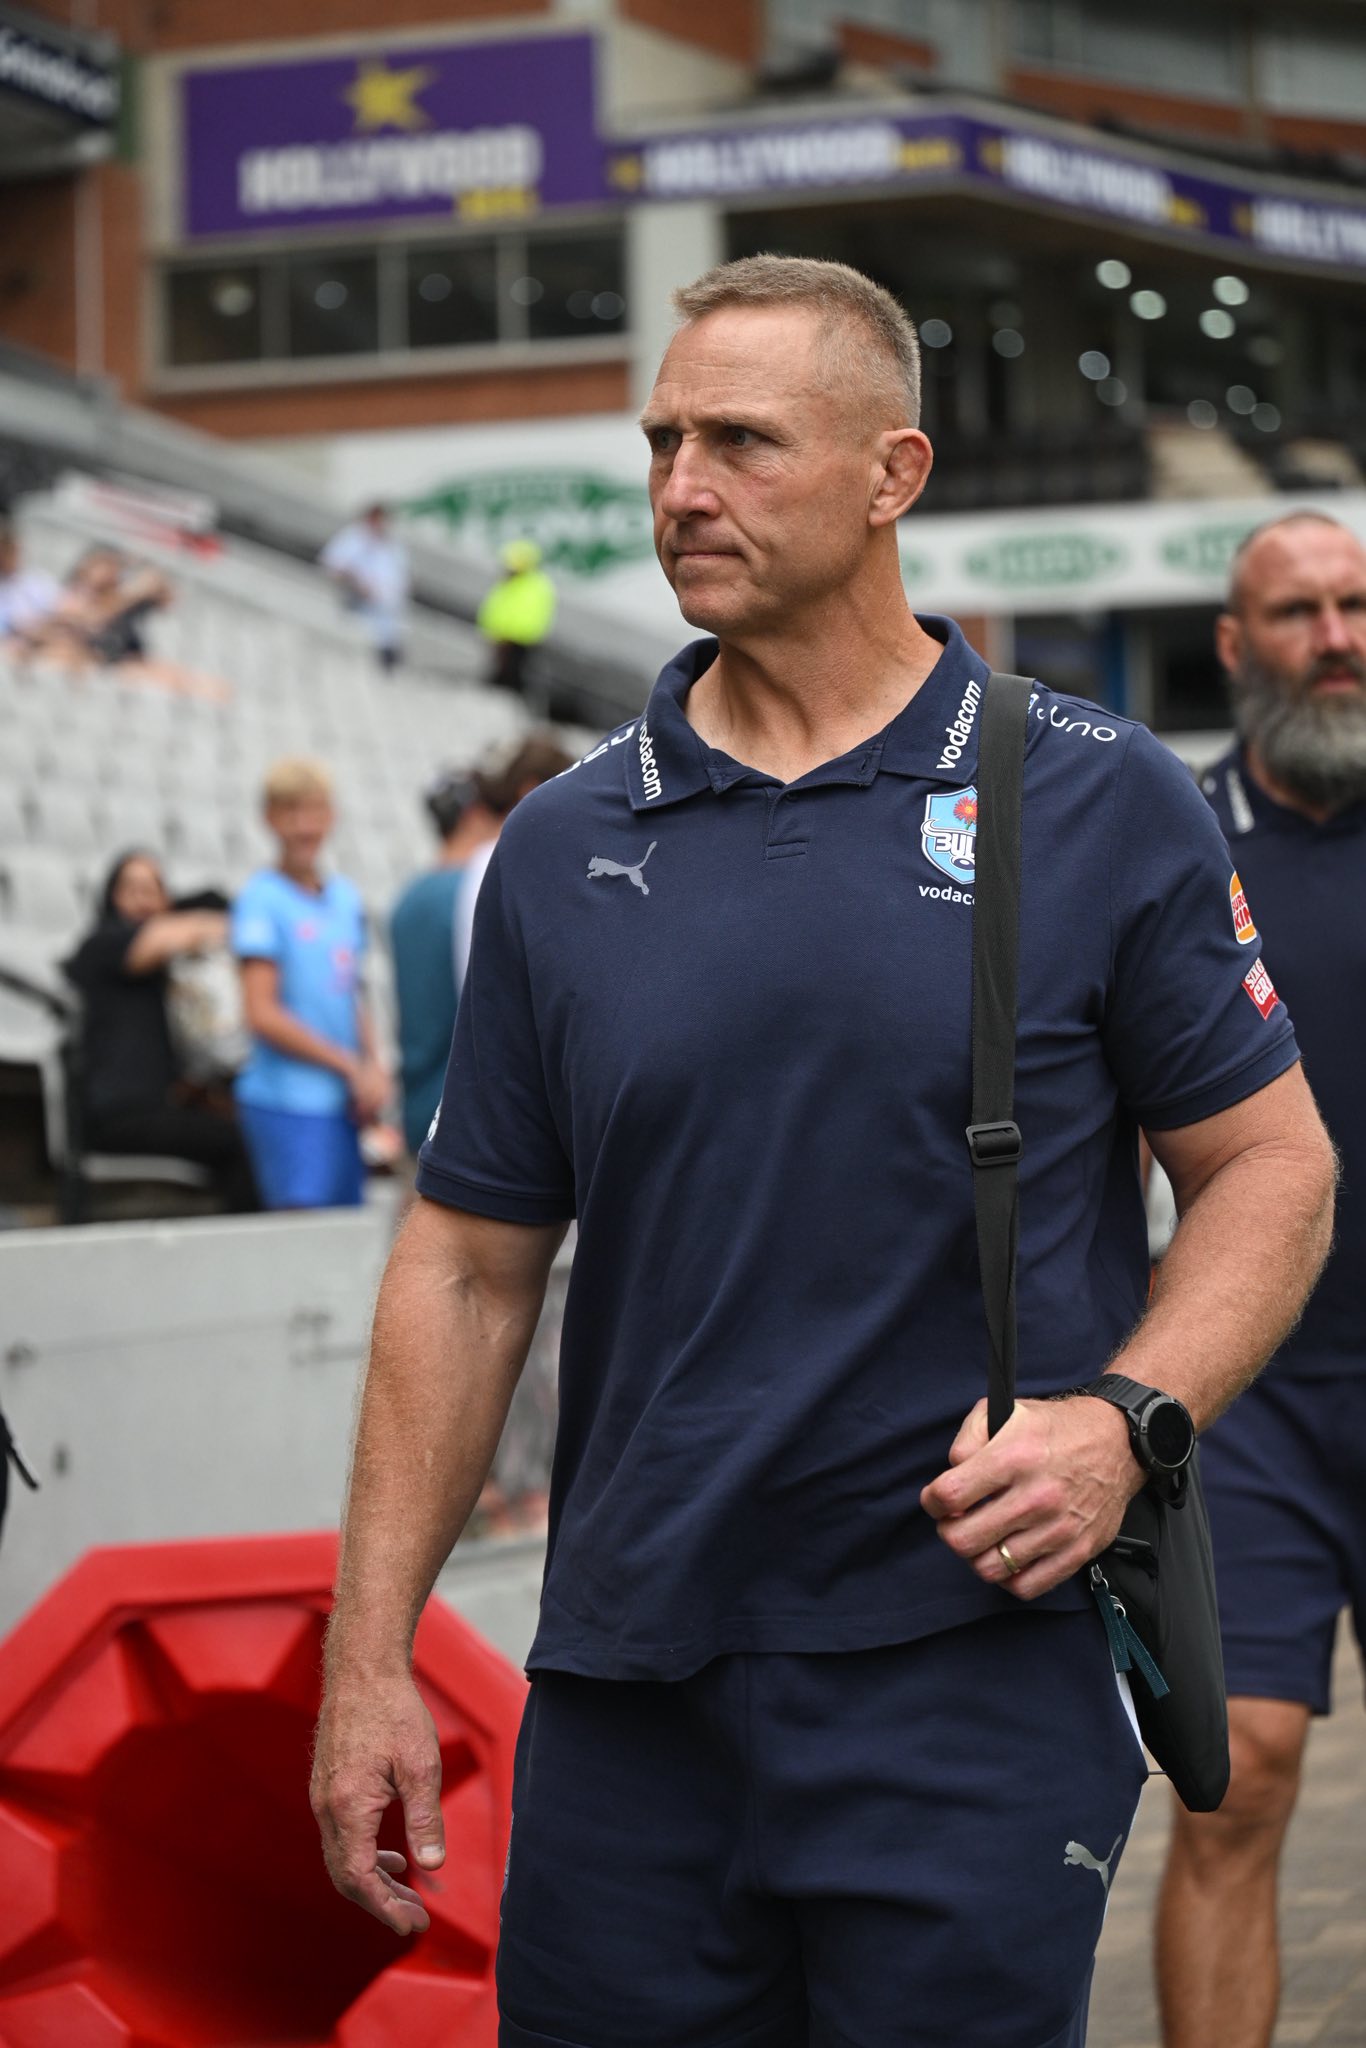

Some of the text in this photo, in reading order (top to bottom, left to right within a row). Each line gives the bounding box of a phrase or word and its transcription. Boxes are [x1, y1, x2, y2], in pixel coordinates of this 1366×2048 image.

[936, 680, 981, 769] vodacom
[918, 885, 975, 905] vodac
[1234, 906, 1250, 932] KIN
